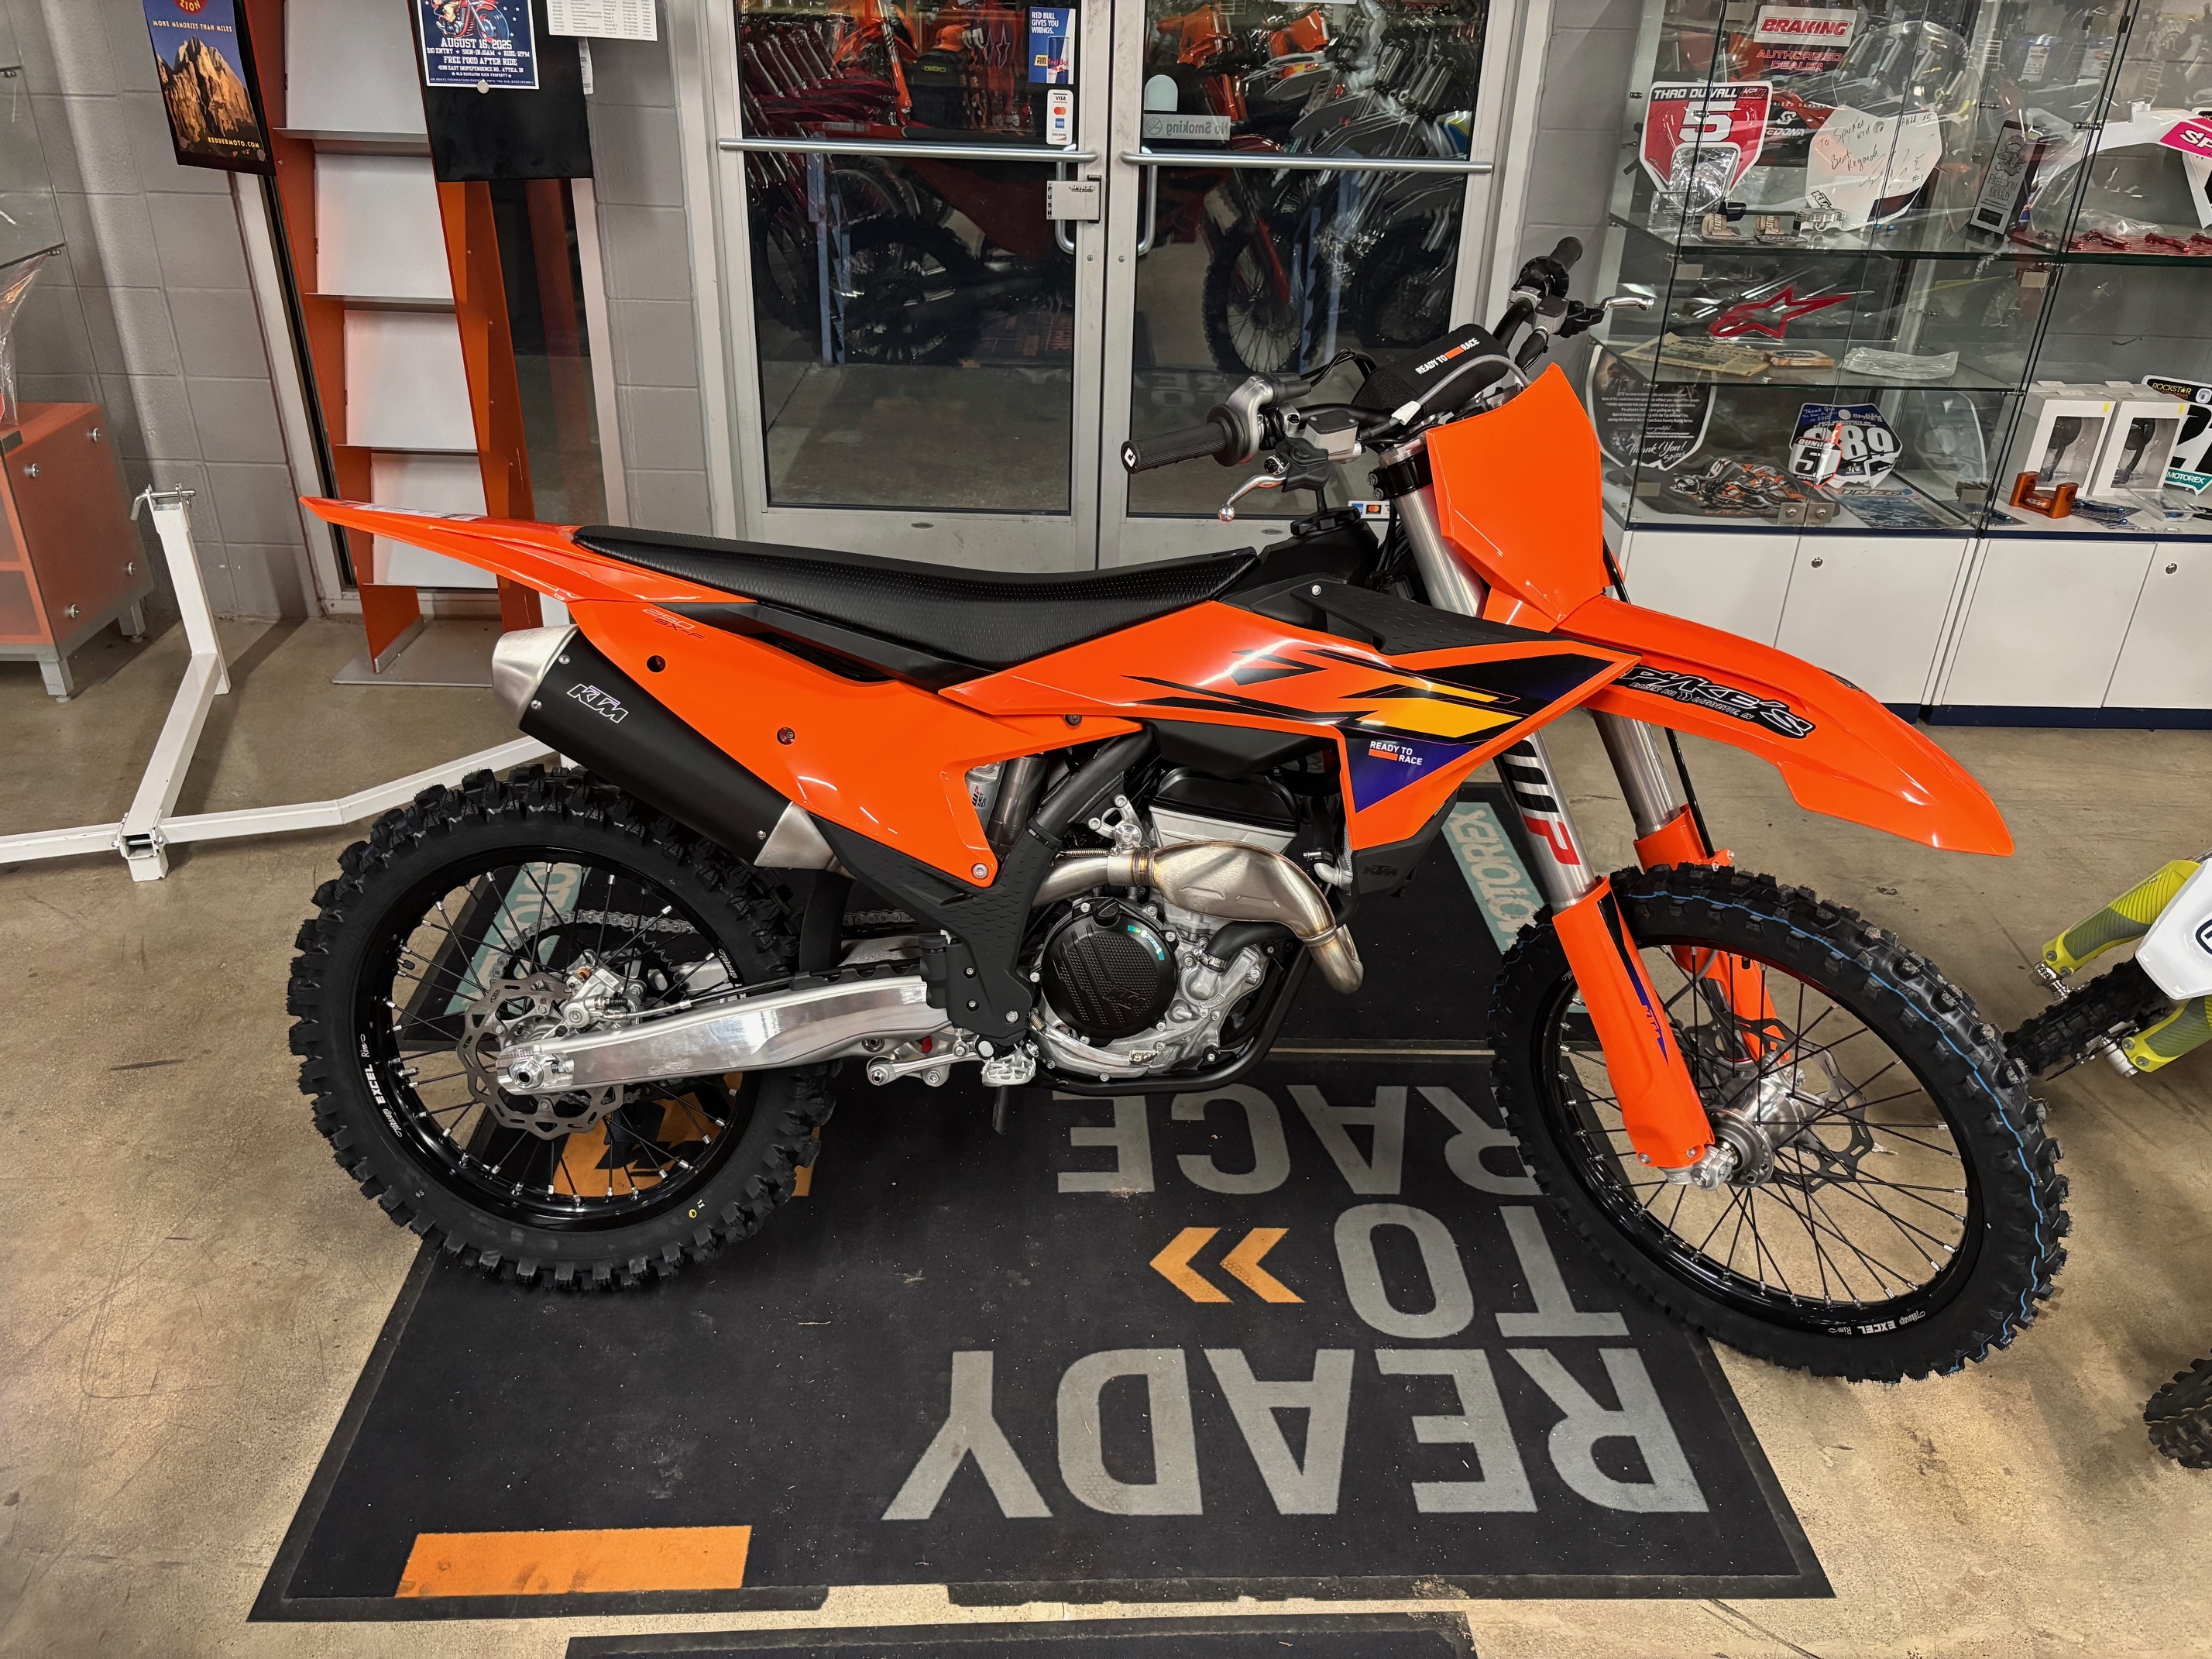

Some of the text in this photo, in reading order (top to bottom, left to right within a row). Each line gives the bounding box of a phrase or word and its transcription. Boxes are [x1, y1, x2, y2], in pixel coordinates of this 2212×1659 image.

[179, 0, 201, 12] ZION
[1759, 17, 1850, 37] BRAKING
[441, 37, 513, 50] AUGUST 16, 2025
[1756, 49, 1843, 62] AUTHORIZED
[1771, 60, 1824, 72] DEALER
[1654, 89, 1688, 99] THAD
[1691, 88, 1738, 99] DUVALL
[1678, 101, 1737, 143] 5
[1766, 128, 1805, 137] EDONA
[208, 136, 260, 148] REDDERMOTO.COM
[1987, 187, 2011, 201] AWARD
[1415, 337, 1480, 375] READY TO RACE
[2166, 472, 2205, 485] MOTOREX
[2025, 497, 2048, 508] KTM
[642, 608, 696, 630] 250
[653, 618, 706, 640] SX-F
[566, 683, 629, 723] KTM
[1620, 666, 1814, 737] PYKE'S
[1369, 740, 1413, 756] READY TO
[1399, 754, 1423, 765] RACE
[1362, 864, 1399, 876] KTM
[365, 1064, 386, 1105] EXCEL
[1052, 1084, 1551, 1197] RACE
[1334, 1202, 1631, 1338] TO
[1856, 1320, 1898, 1334] EXCEL
[880, 1348, 1710, 1520] READY
